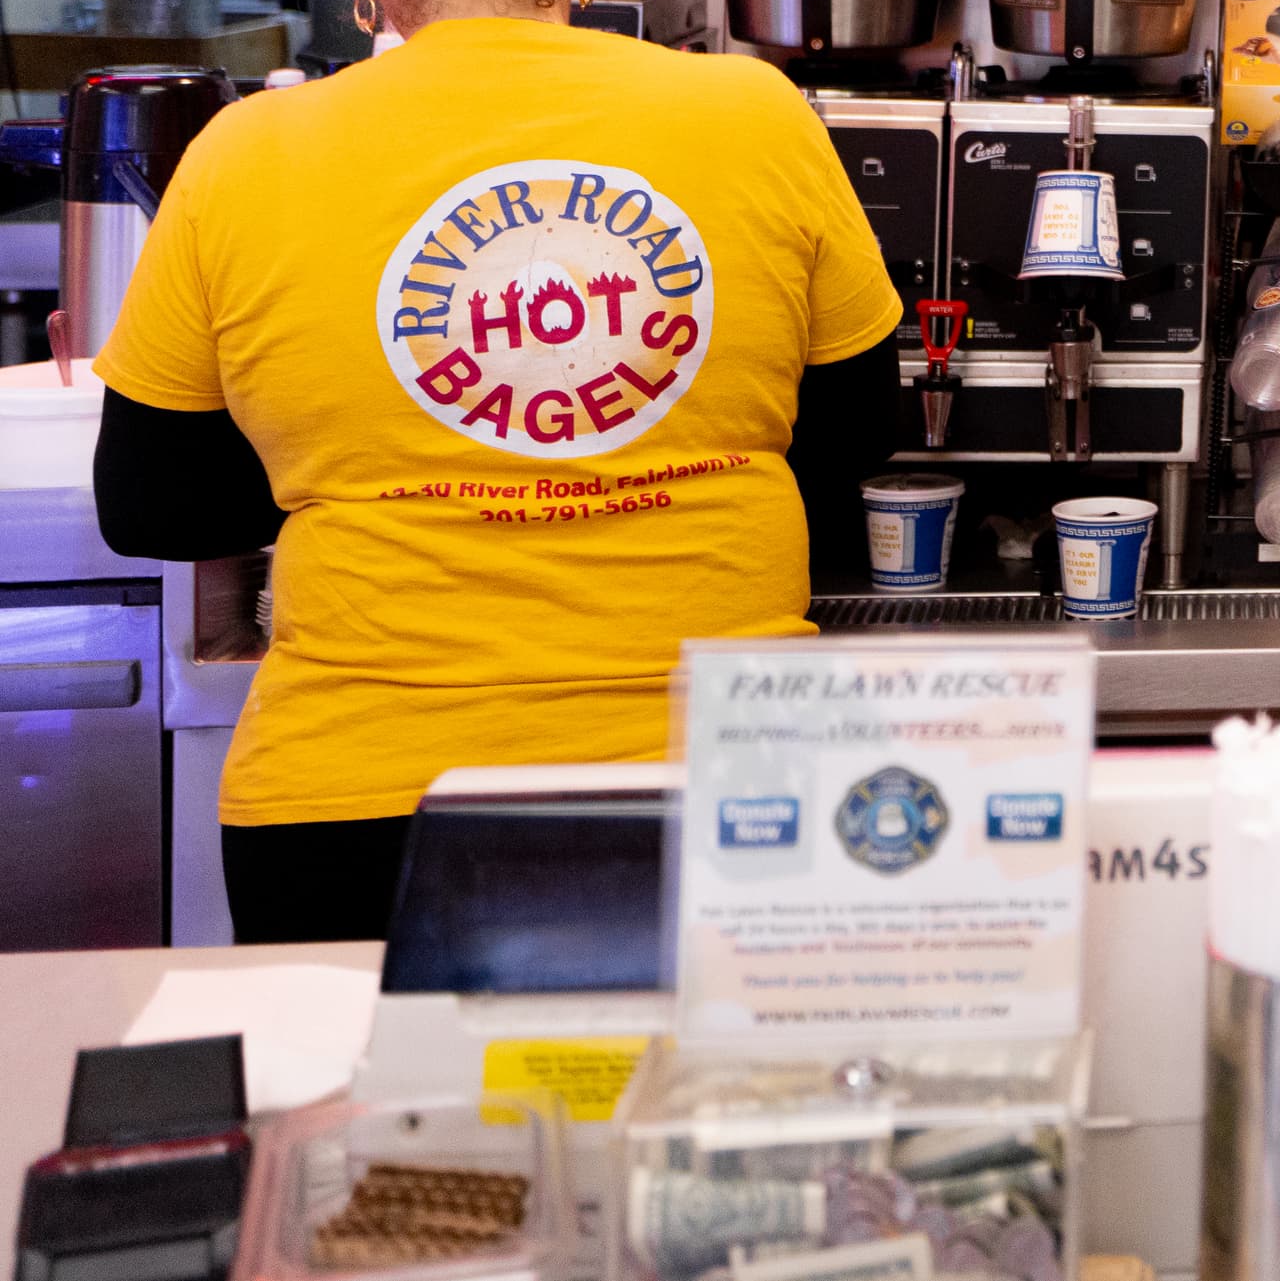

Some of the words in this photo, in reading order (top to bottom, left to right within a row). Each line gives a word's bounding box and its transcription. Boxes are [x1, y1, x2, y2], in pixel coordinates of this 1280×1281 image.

[964, 141, 1007, 163] Curtis
[393, 179, 544, 342] RIVER
[559, 172, 704, 298] ROAD
[468, 271, 638, 353] HOT
[415, 310, 699, 443] BAGELS
[459, 482, 530, 500] River
[535, 477, 611, 500] Road,
[729, 672, 814, 700] FAIR
[822, 669, 923, 700] LAWN
[930, 670, 1064, 699] RESCUE
[734, 822, 781, 842] Now
[1003, 818, 1046, 838] Now
